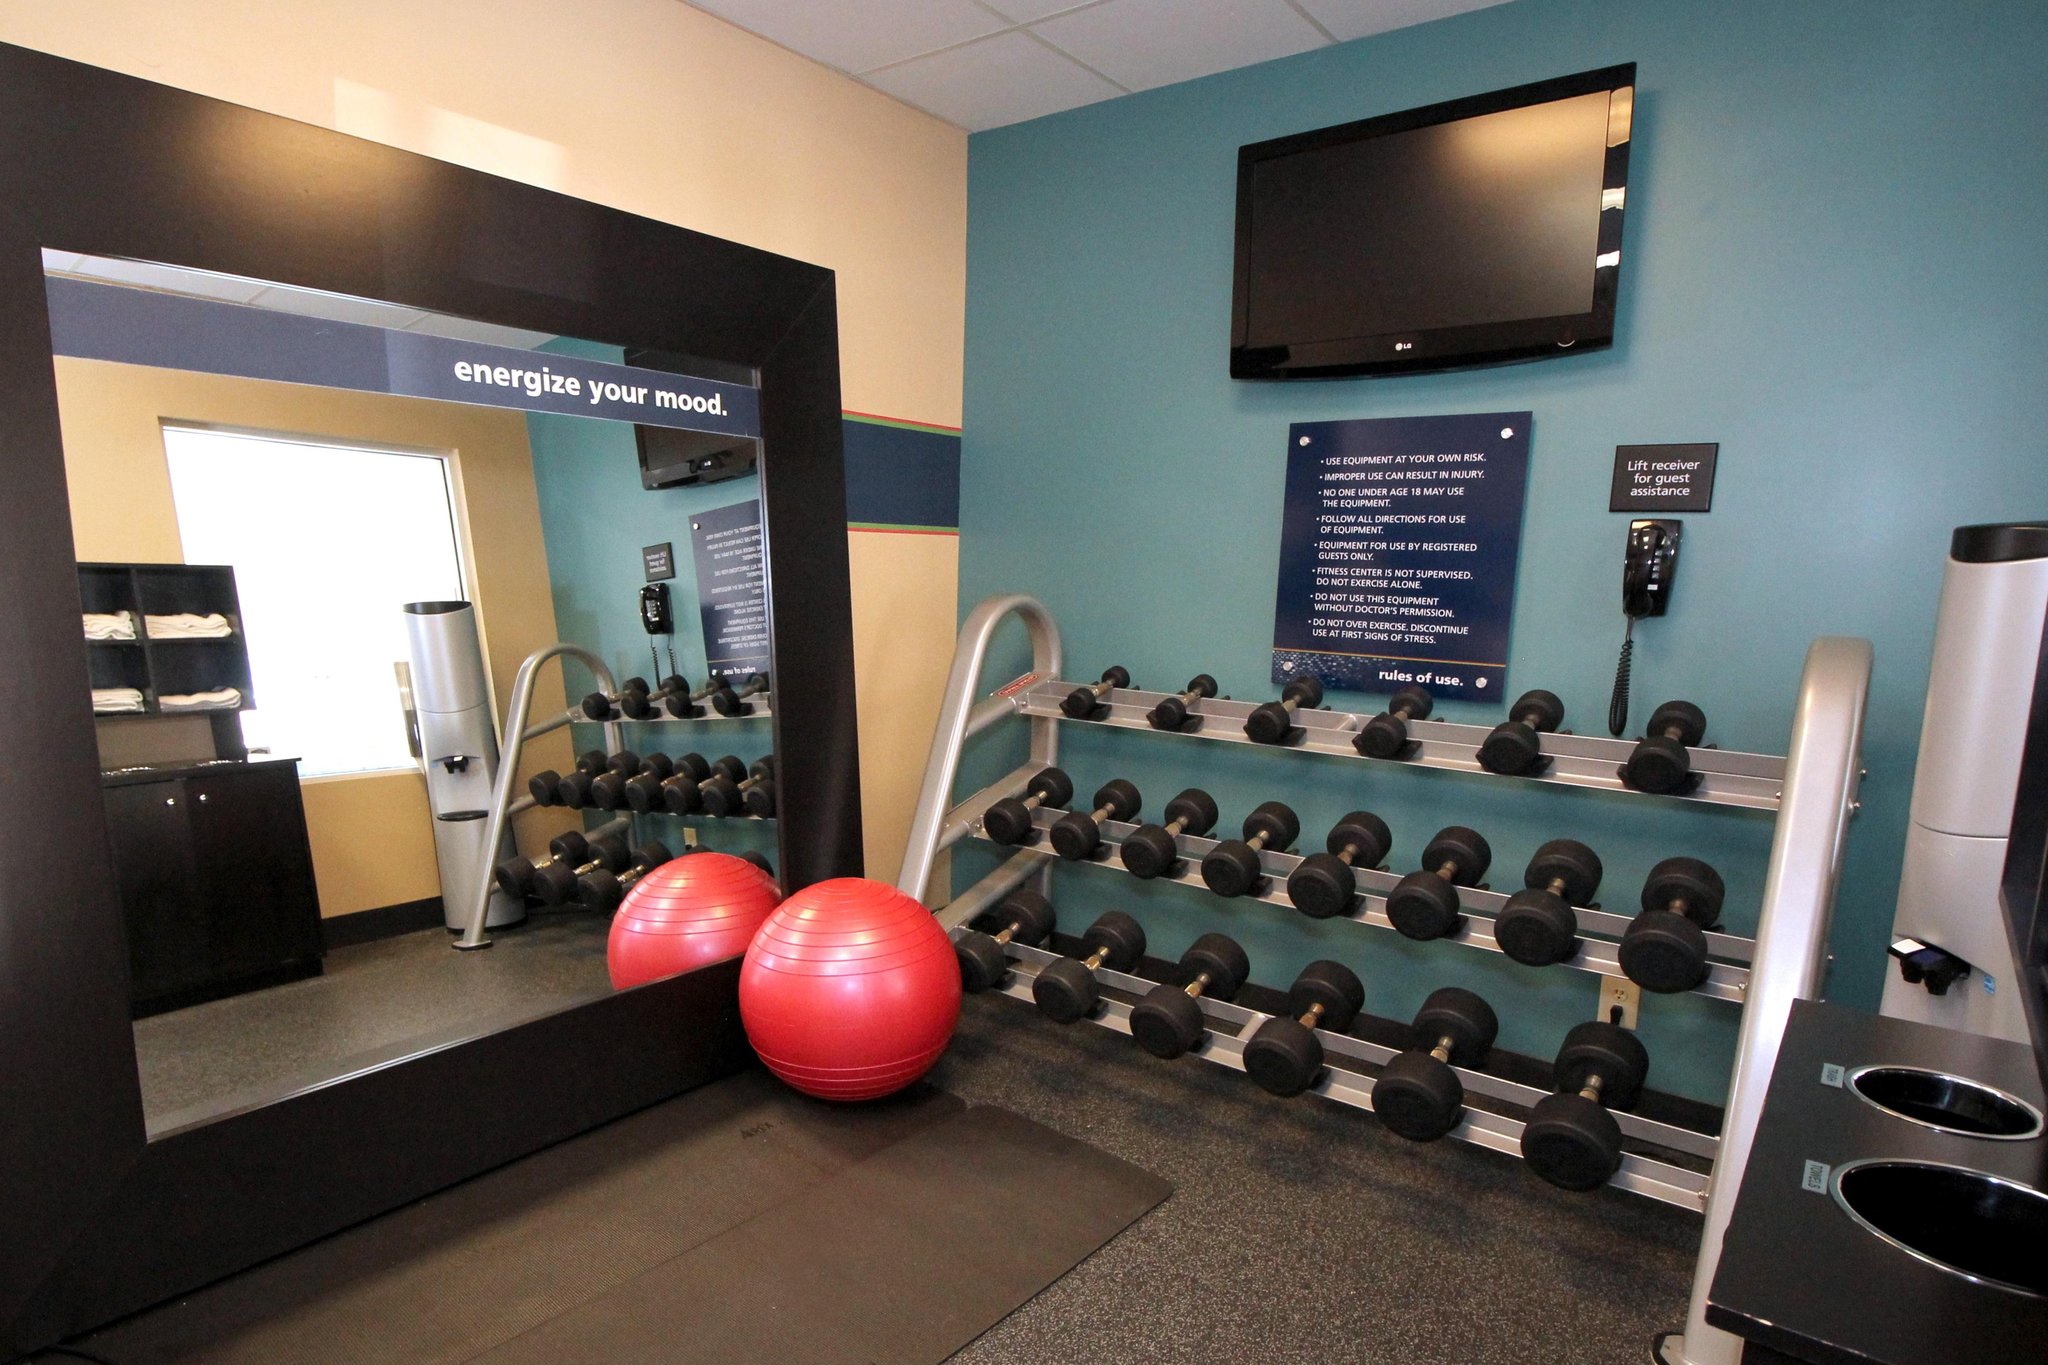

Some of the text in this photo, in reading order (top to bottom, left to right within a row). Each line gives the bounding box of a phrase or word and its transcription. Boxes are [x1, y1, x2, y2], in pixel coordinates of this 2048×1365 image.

[454, 361, 728, 416] energize your mood.
[1325, 453, 1487, 465] USE EQUIPMENT AT YOUR OWN RISK.
[1627, 459, 1700, 471] Lift receiver
[1324, 470, 1484, 481] IMPROPER USE CAN RESULT IN INJURY.
[1634, 473, 1690, 485] for guest
[1323, 487, 1465, 497] NO ONE UNDER AGE 18 MAY USE
[1630, 485, 1690, 496] assistance
[1322, 499, 1391, 508] THE EQUIPMENT.
[1321, 515, 1466, 524] FOLLOW ALL DIRECTIONS FOR USE
[1320, 526, 1384, 535] OF EQUIPMENT.
[1319, 541, 1477, 552] EQUIPMENT FOR USE BY REGISTERED
[1318, 552, 1374, 561] GUESTS ONLY.
[1317, 568, 1473, 580] FITNESS CENTER IS NOT SUPERVISED.
[1316, 578, 1422, 589] DO NOT EXERCISE ALONE.
[1315, 593, 1439, 606] DO NOT USE THIS EQUIPMENT
[1314, 603, 1454, 618] WITHOUT DOCTOR'S PERMISSION.
[1313, 618, 1468, 635] DO NOT OVER EXERCISE. DISCONTINUE
[1312, 629, 1436, 644] USE AT FIRST SIGNS OF STRESS.
[1379, 670, 1463, 686] rules of use.
